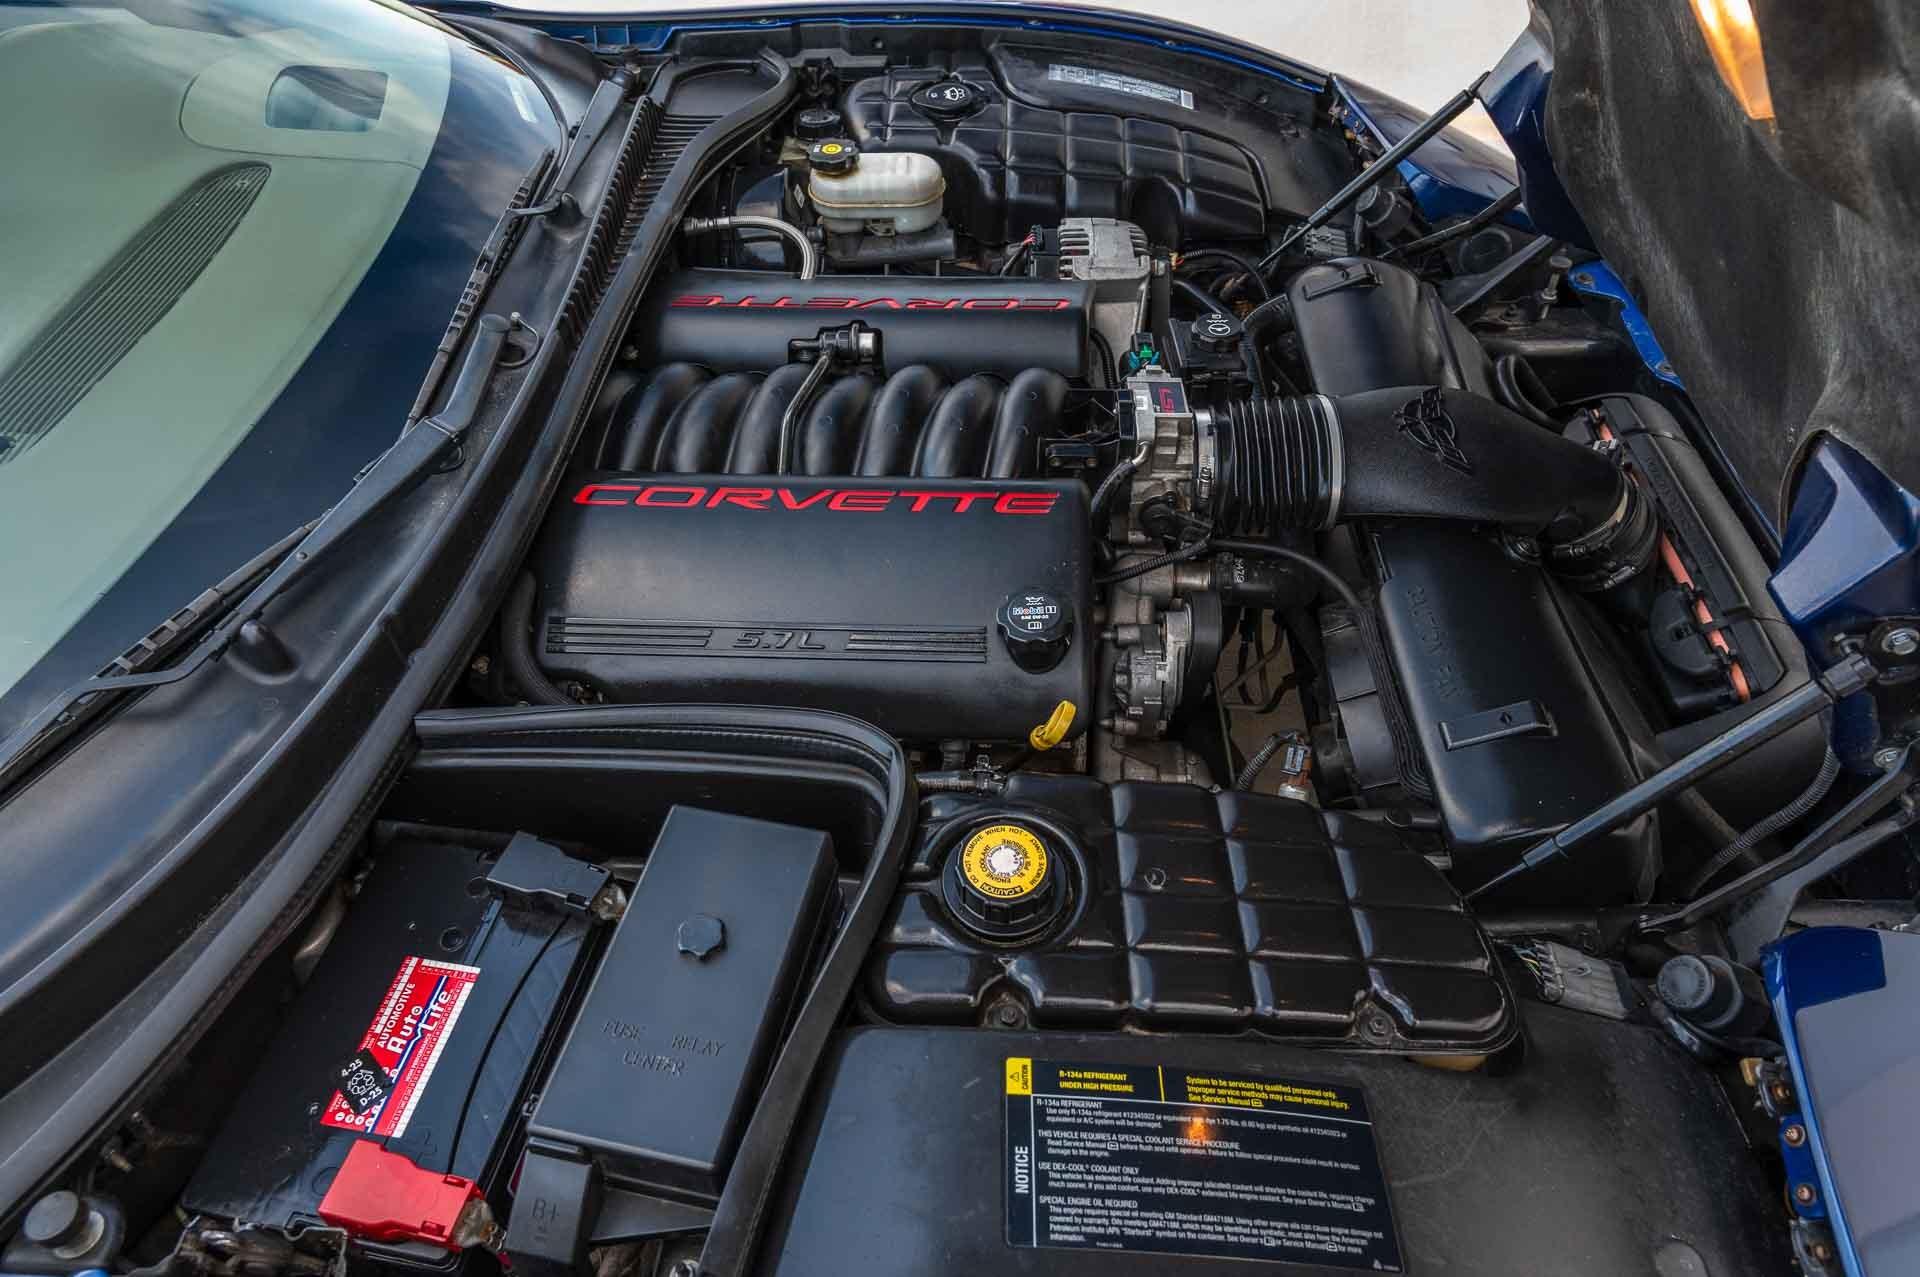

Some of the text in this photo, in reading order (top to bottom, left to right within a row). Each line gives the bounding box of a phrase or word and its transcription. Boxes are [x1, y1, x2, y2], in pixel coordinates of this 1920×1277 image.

[671, 295, 1071, 312] CORVETTE
[573, 485, 1061, 514] CORVETTE
[1013, 607, 1044, 615] Mobil
[732, 630, 827, 650] 5.7L
[984, 826, 1006, 836] WHEN
[966, 833, 984, 858] REMOVE
[964, 860, 972, 872] NOT
[978, 845, 991, 872] COOLANT
[986, 872, 1012, 884] ENGINE
[982, 883, 1016, 896] CAUTION
[376, 982, 416, 1048] AUTOMOTIVE
[420, 990, 452, 1031] Life
[387, 1006, 422, 1054] Auto
[602, 1020, 726, 1057] FUSE RELAY
[411, 1033, 432, 1069] PERFORMANCE
[341, 1058, 364, 1077] 4-25
[624, 1050, 686, 1076] CENTER
[1059, 1069, 1128, 1080] R-134a REFRIGERANT
[1059, 1079, 1134, 1092] UNDER HIGH PRESSURE
[1185, 1075, 1210, 1086] System
[1209, 1078, 1218, 1086] to
[1217, 1079, 1228, 1087] be
[1227, 1080, 1255, 1089] serviced
[1254, 1082, 1264, 1090] by
[1263, 1083, 1291, 1093] qualified
[1290, 1086, 1322, 1097] personnel
[360, 1086, 384, 1106] D-25
[1036, 1097, 1103, 1109] R-134a REFRIGERANT
[1186, 1084, 1216, 1094] Improper
[1216, 1087, 1241, 1097] service
[1240, 1089, 1268, 1099] methods
[1268, 1092, 1283, 1101] may
[1283, 1094, 1303, 1103] cause
[1302, 1097, 1330, 1108] personal
[1187, 1092, 1251, 1106] See Service Manual
[1046, 1106, 1057, 1114] Use
[1057, 1107, 1070, 1115] only
[1070, 1108, 1092, 1116] R-134a
[1083, 1116, 1095, 1125] A/C
[1094, 1117, 1115, 1126] system
[1115, 1118, 1126, 1126] will
[1038, 1128, 1240, 1149] THIS VEHICLE REQUIRES A SPECIAL COOLANT SERVICE PROCEDURE
[1047, 1137, 1062, 1146] Read
[1062, 1138, 1084, 1147] Service
[1084, 1140, 1107, 1149] Manual
[1015, 1145, 1029, 1194] NOTICE
[1038, 1161, 1139, 1174] USE COOLANT ONLY
[1048, 1170, 1061, 1178] This
[1154, 1177, 1176, 1186] Adding
[1039, 1194, 1138, 1209] SPECIAL ENGINE OIL REQUIRED
[1049, 1205, 1062, 1213] This
